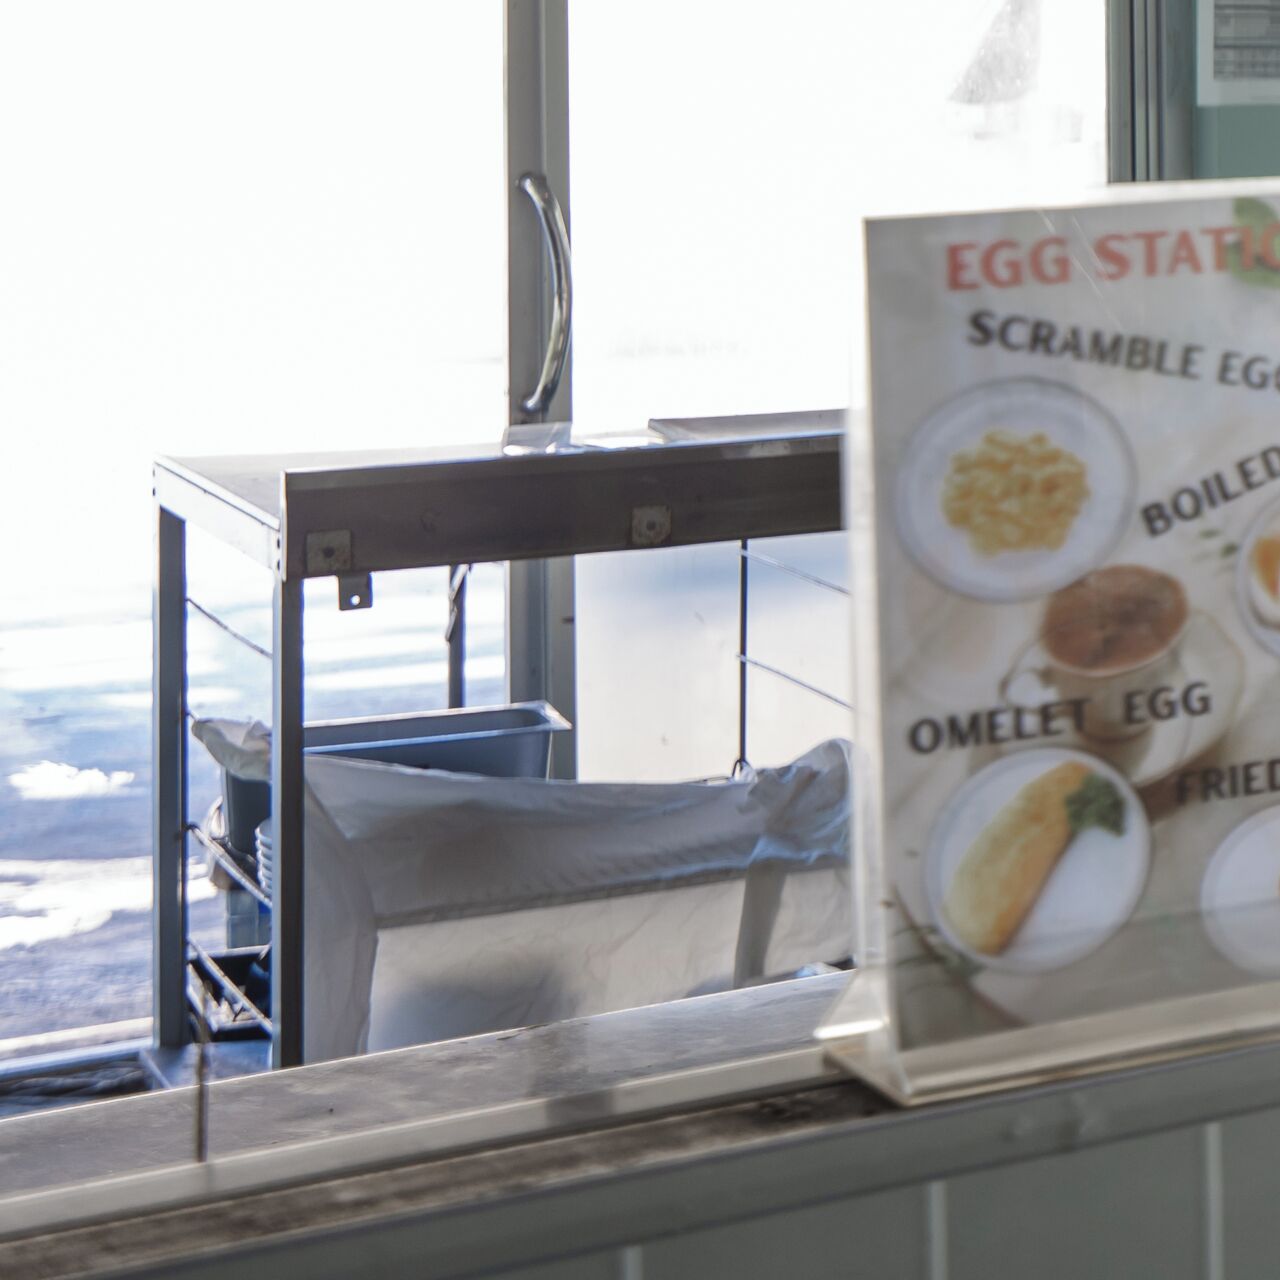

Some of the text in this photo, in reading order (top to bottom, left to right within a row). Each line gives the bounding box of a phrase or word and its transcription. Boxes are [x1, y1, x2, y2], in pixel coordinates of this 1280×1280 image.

[946, 238, 1072, 291] EGG
[967, 311, 1204, 381] SCRAMBLE
[909, 682, 1213, 756] OMELET EGG
